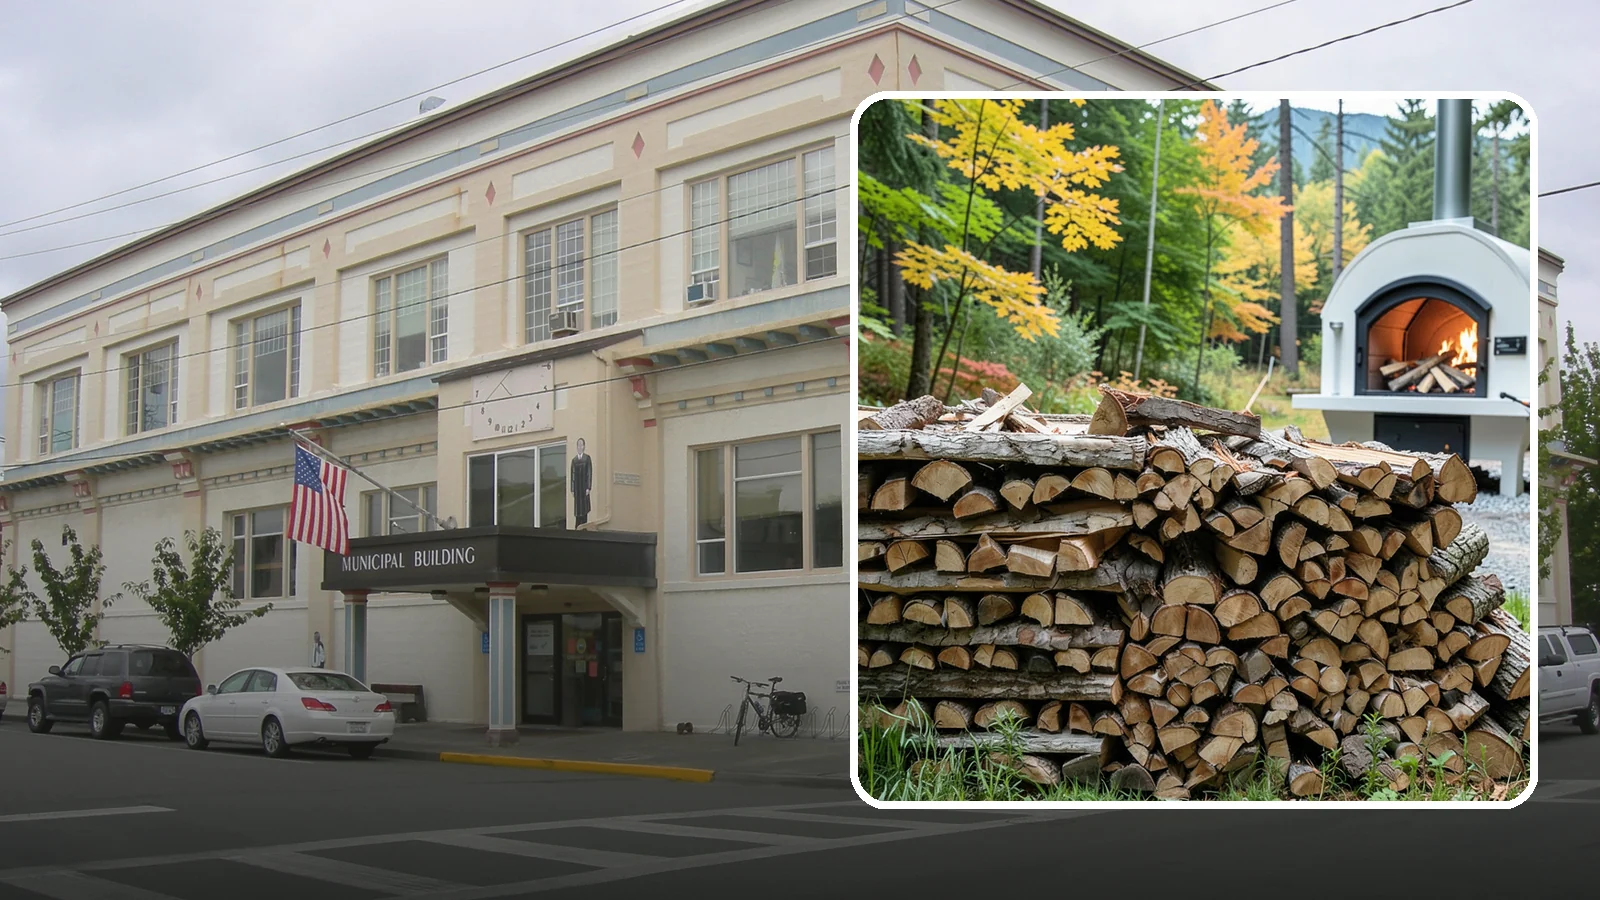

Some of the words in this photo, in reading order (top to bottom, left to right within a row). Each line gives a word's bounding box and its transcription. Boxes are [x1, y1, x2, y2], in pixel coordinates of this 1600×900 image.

[546, 361, 552, 371] 6
[475, 390, 479, 398] 7
[480, 406, 485, 415] 8
[536, 402, 540, 410] 4
[488, 417, 493, 426] 9
[529, 413, 533, 422] 3
[494, 423, 500, 432] 10
[521, 420, 526, 428] 2
[507, 425, 513, 433] 12
[342, 552, 405, 572] MUNICIPAL
[414, 546, 475, 567] BUILDING
